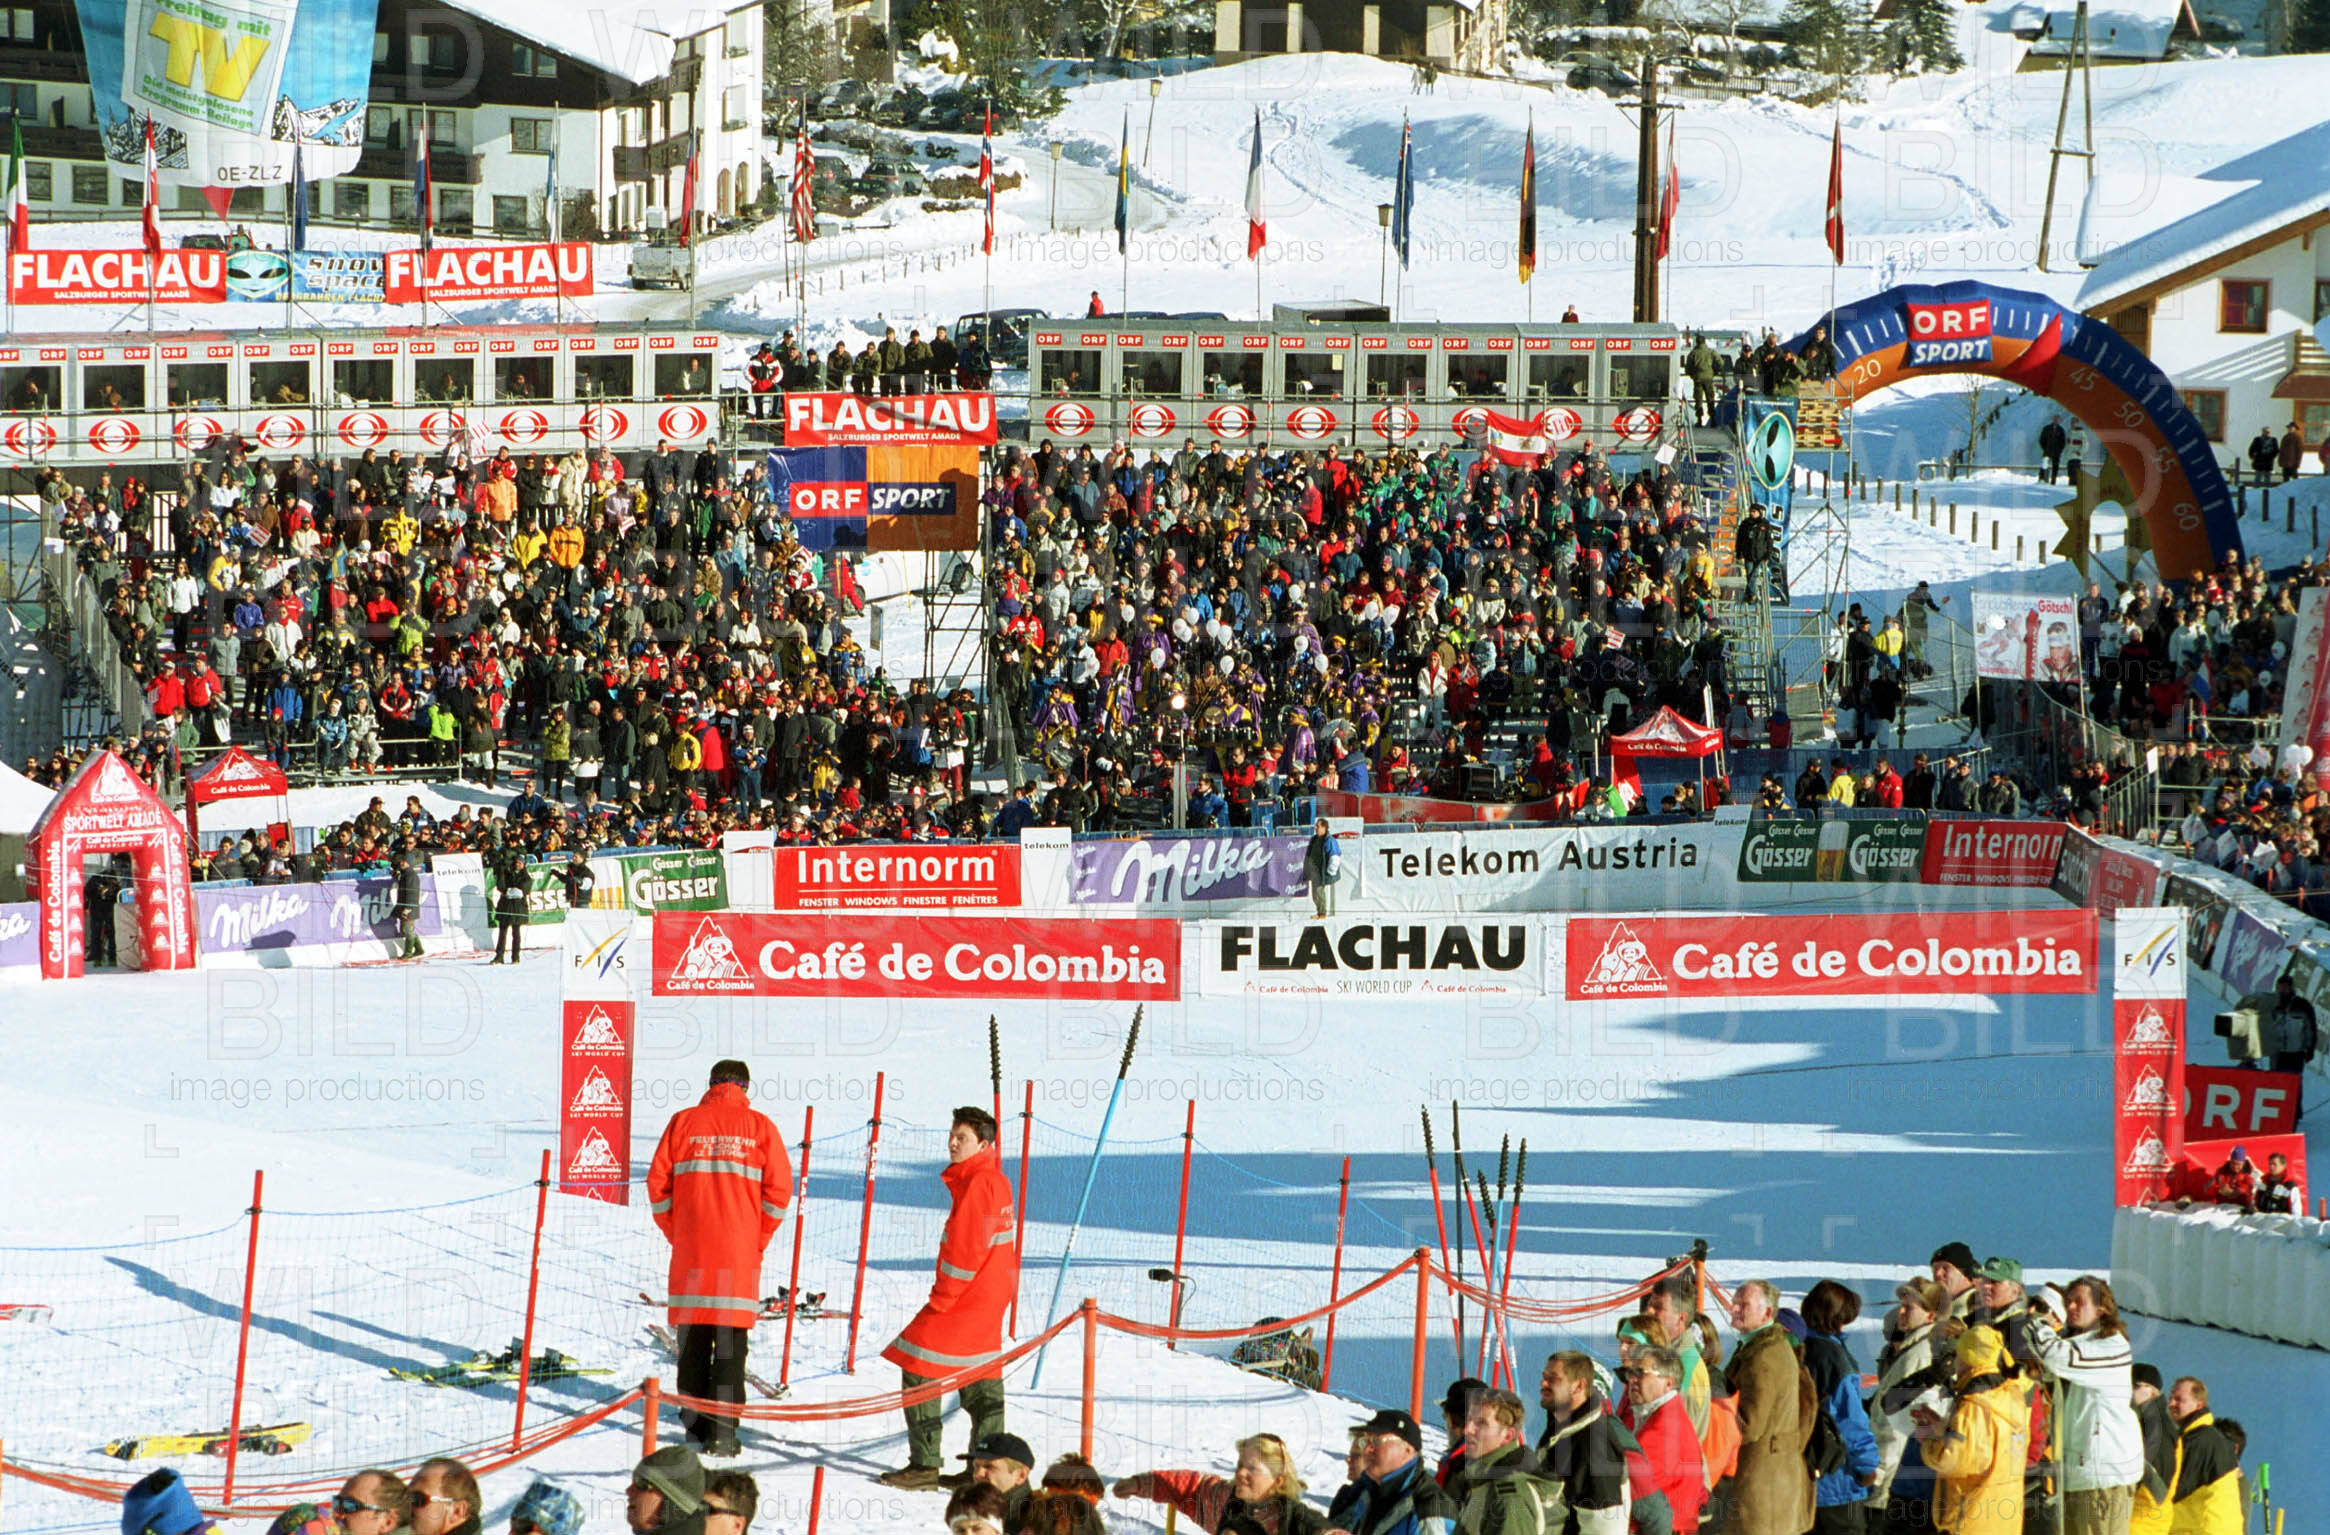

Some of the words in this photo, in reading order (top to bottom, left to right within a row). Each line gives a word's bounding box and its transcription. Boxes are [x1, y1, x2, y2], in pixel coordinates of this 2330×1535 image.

[237, 20, 271, 36] mit
[148, 11, 271, 102] TV
[217, 166, 282, 182] OE-ZLZ
[14, 252, 220, 289] FLACHAU
[389, 247, 588, 289] FLACHAU
[54, 290, 108, 299] SALZBURGER
[429, 287, 482, 298] SALZBURGER
[483, 286, 529, 295] SPORTWELT
[1913, 307, 1987, 334] ORF
[616, 339, 637, 348] ORF
[651, 339, 672, 347] ORF
[695, 338, 716, 346] ORF
[1037, 334, 1060, 344] ORF
[1082, 335, 1105, 344] ORF
[1119, 336, 1142, 345] ORF
[1164, 337, 1187, 346] ORF
[1199, 337, 1223, 346] ORF
[1244, 338, 1267, 346] ORF
[1281, 338, 1303, 347] ORF
[1327, 339, 1349, 347] ORF
[1364, 339, 1386, 347] ORF
[1409, 340, 1431, 348] ORF
[1444, 339, 1467, 348] ORF
[1489, 340, 1512, 348] ORF
[1526, 339, 1549, 348] ORF
[1571, 339, 1593, 348] ORF
[1607, 339, 1630, 349] ORF
[1651, 339, 1674, 349] ORF
[330, 345, 352, 353] ORF
[375, 344, 397, 352] ORF
[411, 344, 433, 352] ORF
[456, 343, 477, 351] ORF
[491, 342, 513, 351] ORF
[536, 341, 557, 350] ORF
[571, 340, 593, 349] ORF
[42, 350, 65, 359] ORF
[79, 350, 102, 359] ORF
[125, 348, 148, 358] ORF
[163, 349, 185, 357] ORF
[209, 348, 231, 356] ORF
[246, 347, 268, 355] ORF
[291, 346, 313, 354] ORF
[1914, 340, 1988, 364] SPORT
[1853, 359, 1882, 386] 20
[2070, 366, 2098, 392] 45
[788, 397, 990, 432] FLACHAU
[2113, 400, 2146, 429] 50
[828, 433, 881, 441] SALZBURGER
[883, 432, 929, 441] SPORTWELT
[2155, 446, 2178, 475] 55
[795, 489, 862, 511] ORF
[871, 487, 951, 510] SPORT
[2172, 502, 2200, 532] 60
[1024, 841, 1070, 849] telekom
[1379, 846, 1539, 879] Telekom
[1557, 836, 1698, 872] Austria
[1746, 834, 1814, 875] Gösser
[1850, 834, 1920, 875] Gösser
[652, 857, 684, 871] Gösser
[798, 850, 996, 884] Internorm
[47, 840, 61, 907] Colombia
[1111, 838, 1274, 901] Milka
[629, 868, 720, 910] Gösser
[798, 897, 840, 907] FENSTER
[844, 896, 898, 906] WINDOWS
[903, 895, 948, 905] FINESTRE
[952, 892, 998, 905] FENÊTRES
[209, 889, 310, 948] Milka
[1220, 925, 1527, 972] FLACHAU
[759, 938, 866, 981] Café
[879, 943, 933, 981] de
[944, 942, 1167, 984] Colombia
[1672, 939, 1779, 980] Café
[1791, 938, 1847, 978] de
[1857, 936, 2083, 978] Colombia
[666, 979, 691, 991] Café
[692, 980, 704, 990] de
[706, 979, 755, 990] Colombia
[1279, 986, 1288, 994] de
[1336, 980, 1353, 994] SKI
[1355, 980, 1391, 994] WORLD
[1392, 979, 1413, 994] CUP
[1457, 985, 1467, 993] de
[1580, 982, 1604, 994] Café
[1605, 982, 1618, 993] de
[1619, 981, 1668, 993] Colombia
[2184, 1083, 2287, 1131] RF
